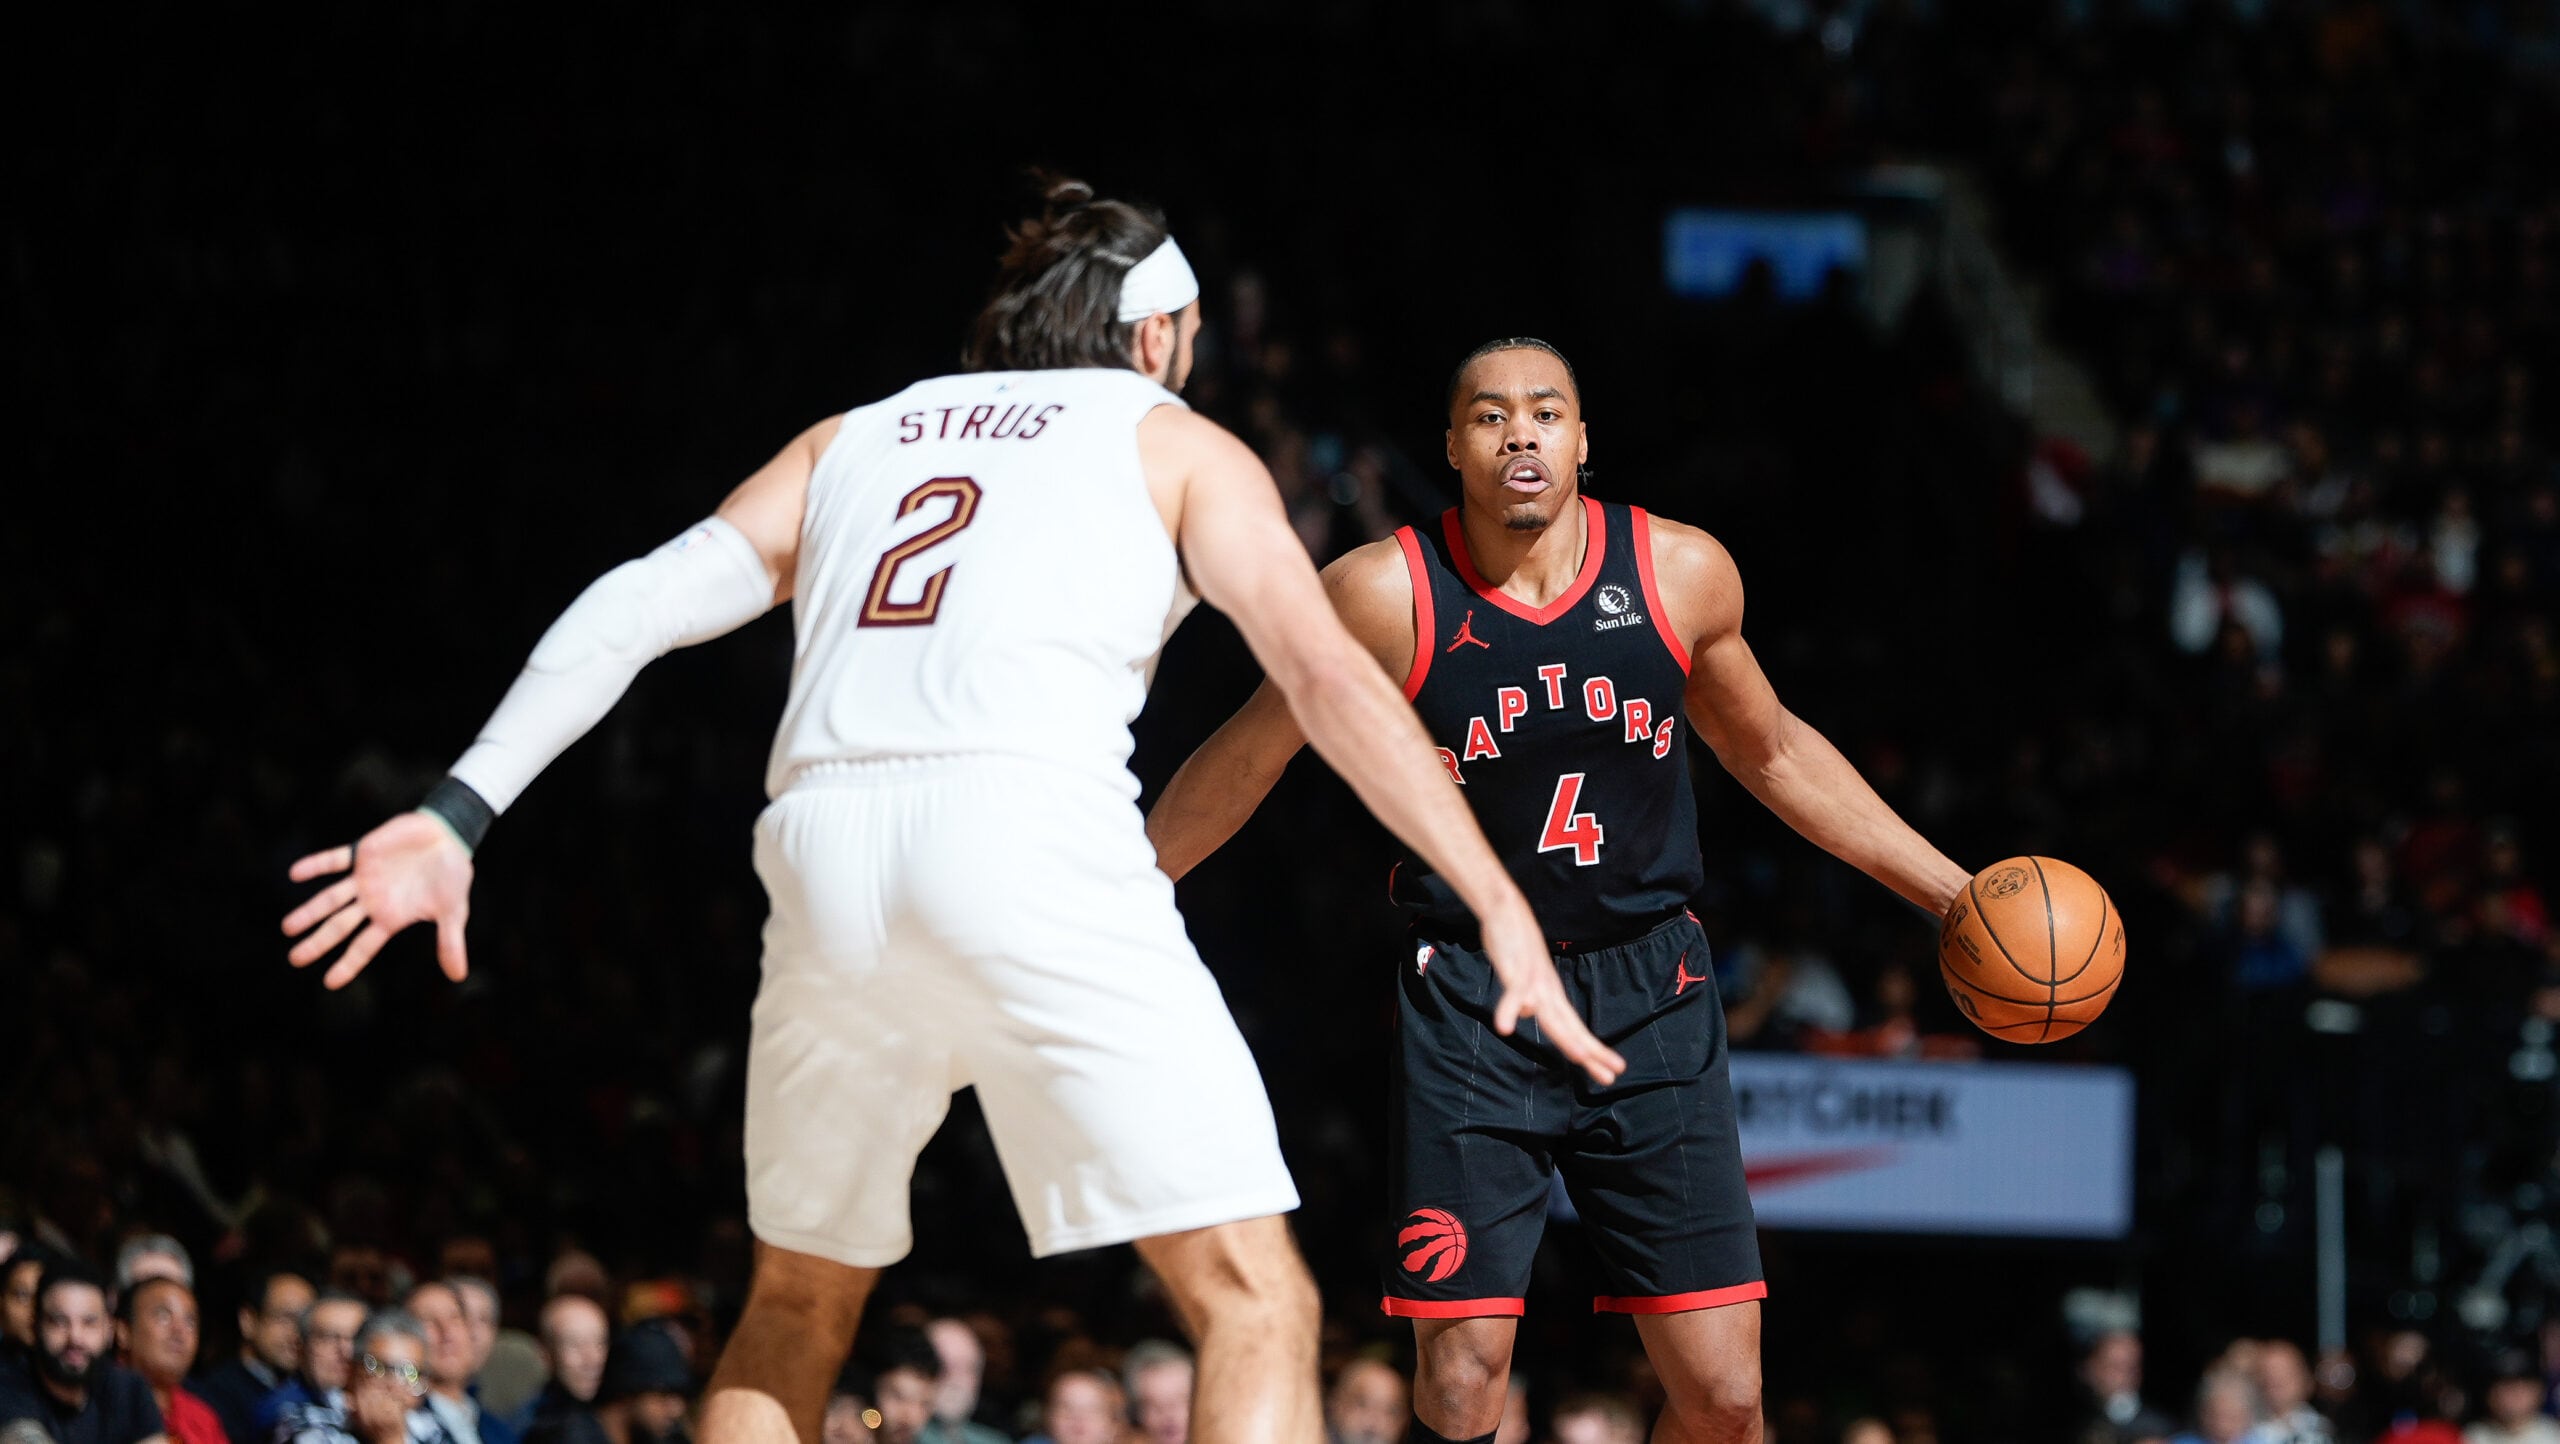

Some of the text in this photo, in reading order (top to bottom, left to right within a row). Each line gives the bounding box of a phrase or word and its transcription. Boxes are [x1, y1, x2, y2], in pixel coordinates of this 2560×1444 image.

[900, 403, 1065, 443] STRUS
[857, 476, 982, 629] 2
[1595, 612, 1642, 631] Sun Life
[1433, 663, 1674, 784] RAPTORS
[1537, 772, 1604, 866] 4
